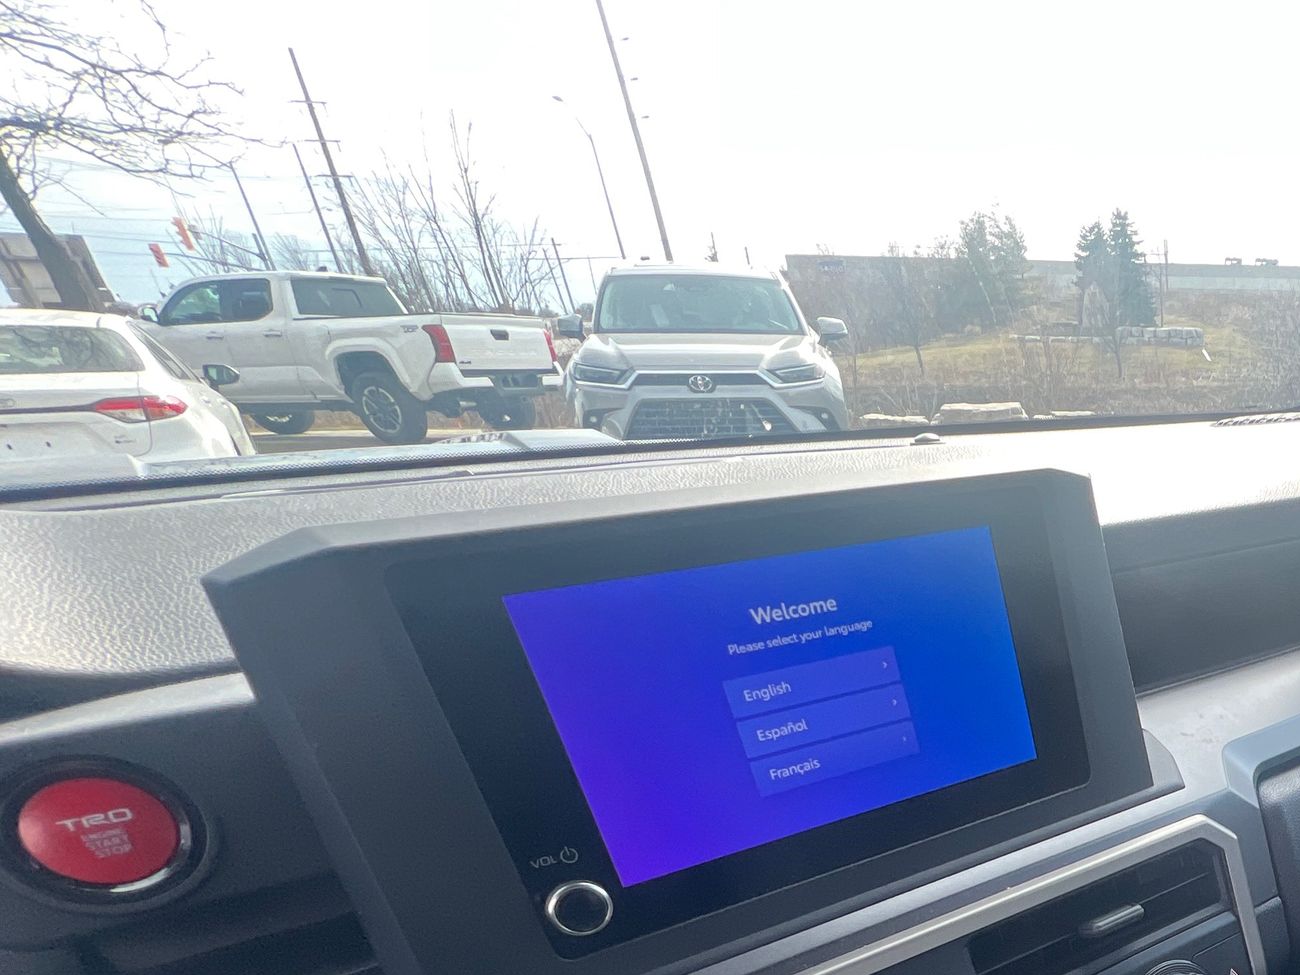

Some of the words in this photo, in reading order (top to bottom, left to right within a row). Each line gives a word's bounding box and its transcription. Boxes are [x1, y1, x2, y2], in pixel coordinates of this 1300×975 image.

[749, 598, 838, 625] Welcome
[727, 641, 765, 656] Please
[766, 634, 798, 649] select
[799, 630, 823, 644] your
[824, 620, 873, 637] language
[743, 681, 792, 702] English
[756, 719, 809, 741] Español
[769, 758, 821, 780] Français
[55, 808, 133, 832] TRD
[530, 855, 557, 869] VOL
